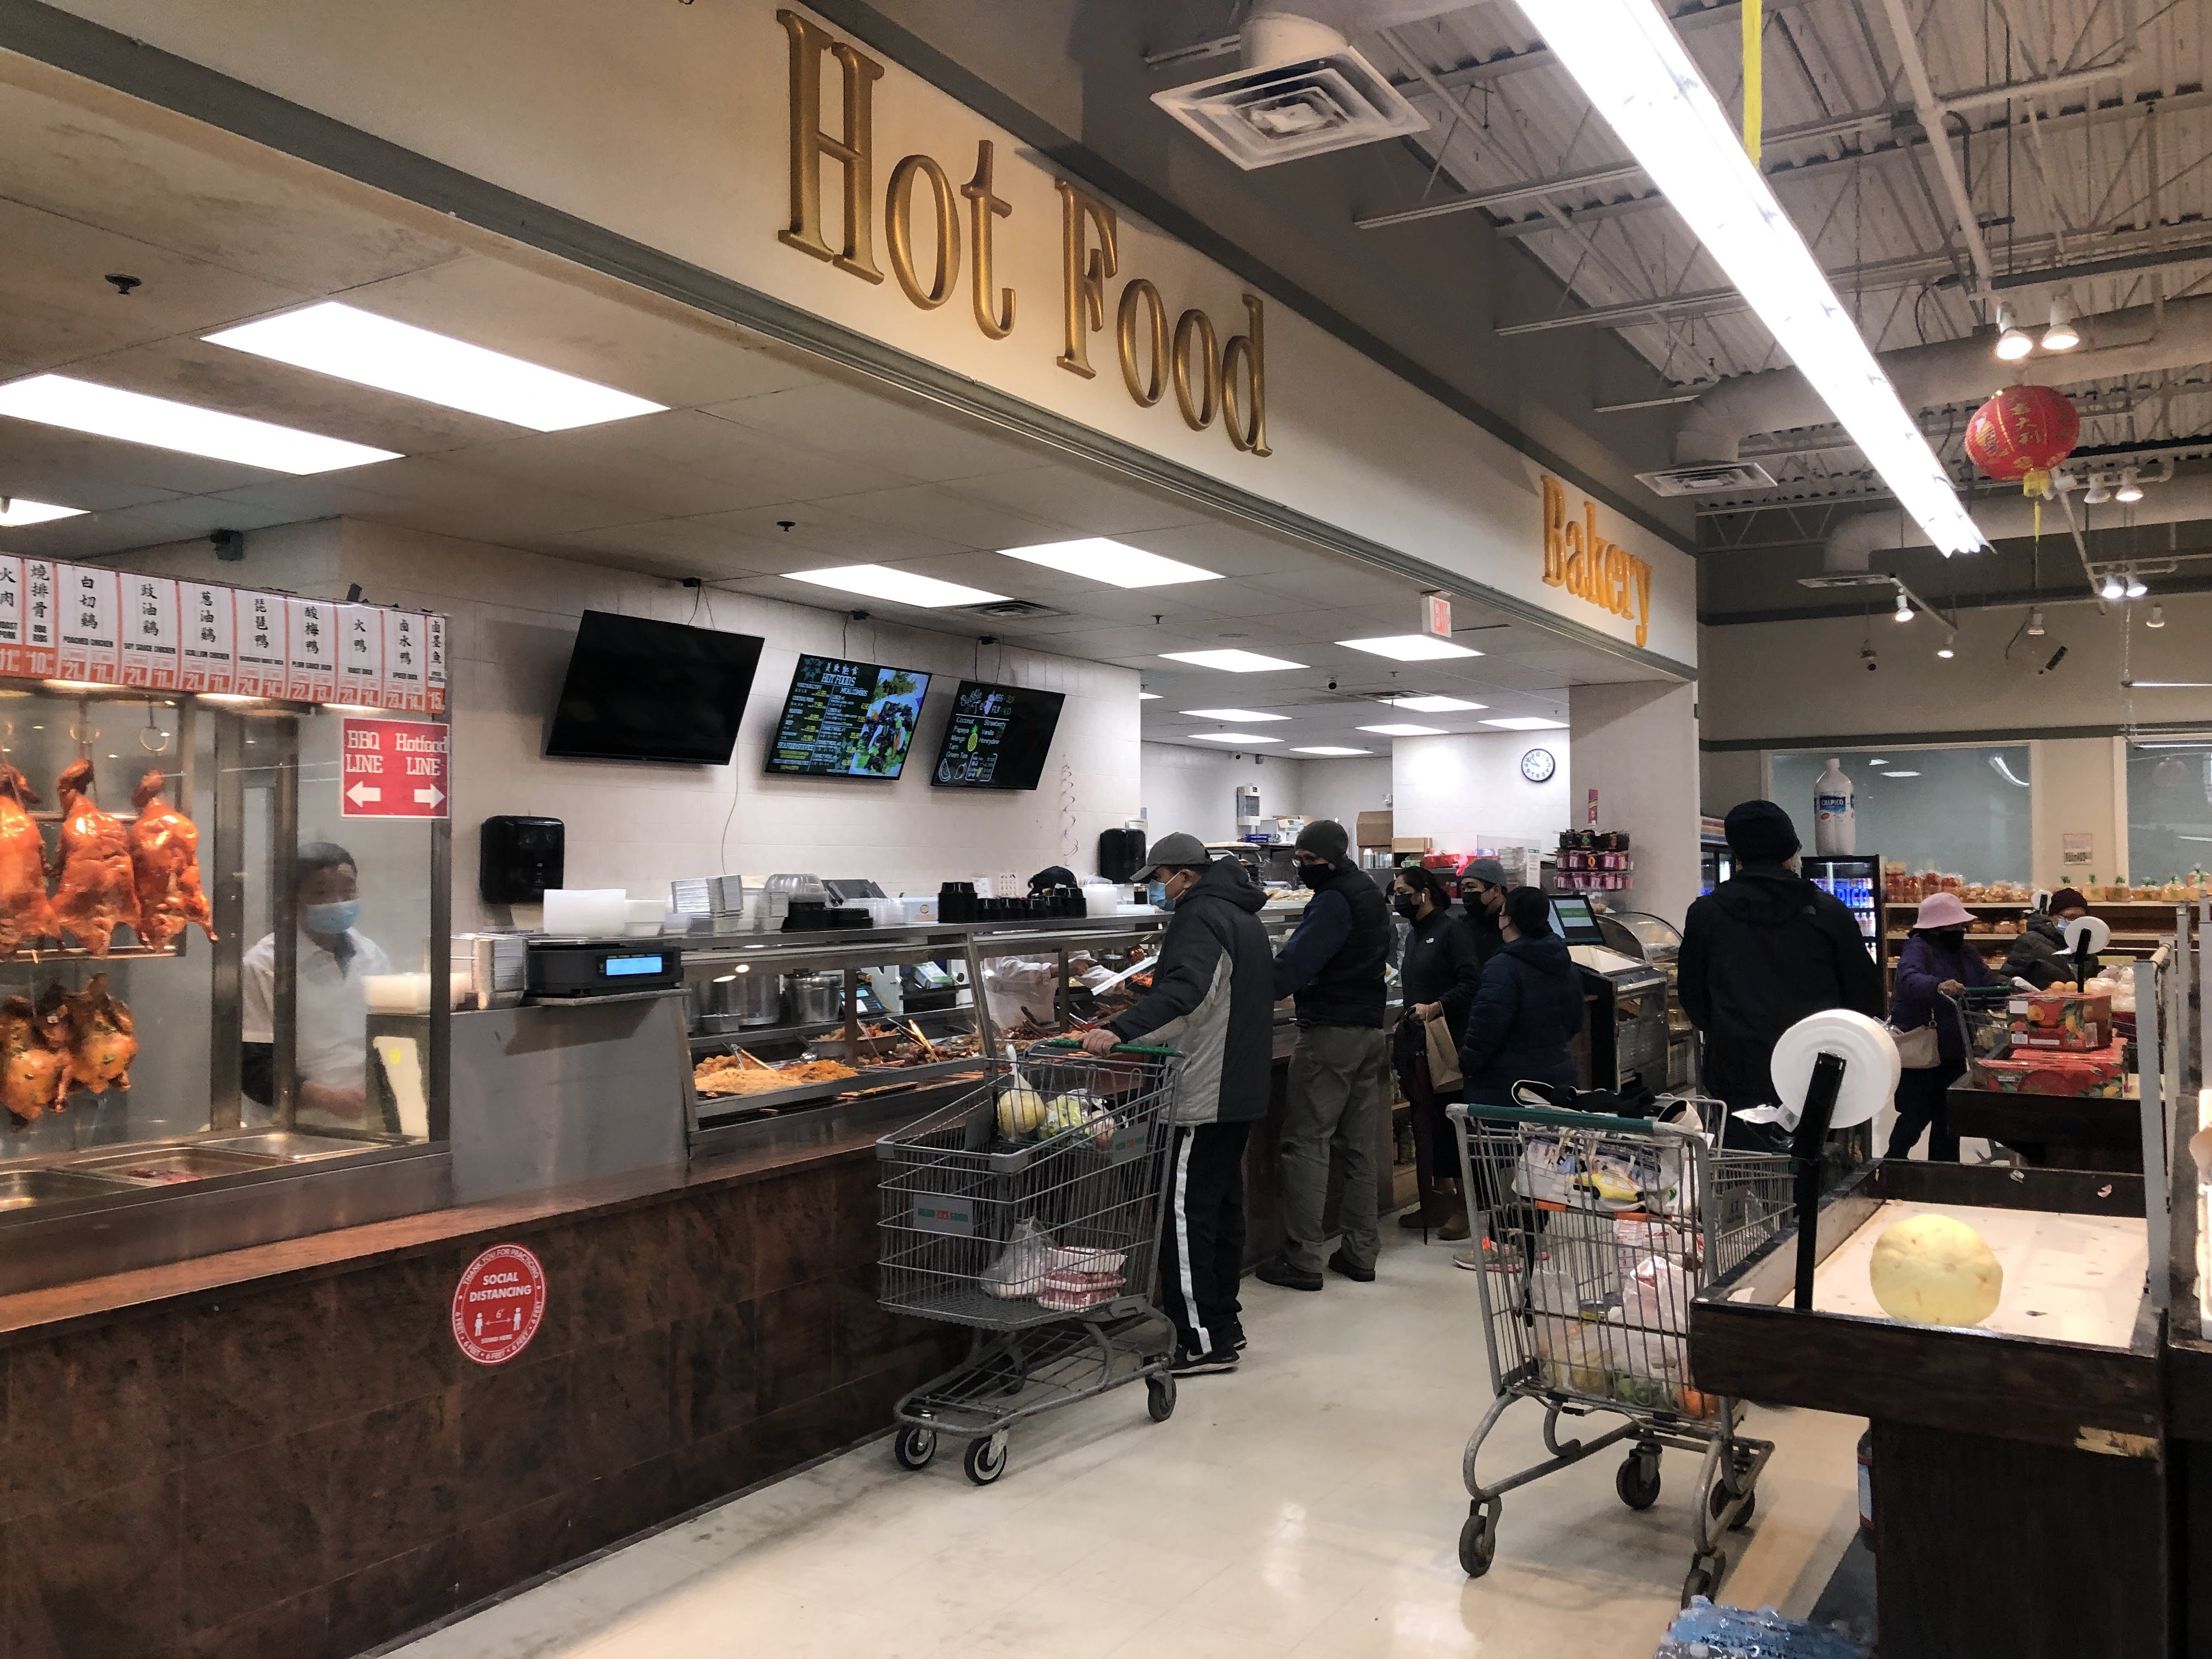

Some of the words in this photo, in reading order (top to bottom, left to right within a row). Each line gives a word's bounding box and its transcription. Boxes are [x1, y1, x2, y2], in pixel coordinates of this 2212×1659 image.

[777, 8, 1015, 340] Hot
[1054, 178, 1272, 458] Food
[1541, 475, 1652, 647] Bakery
[834, 675, 856, 686] FOODS
[961, 689, 982, 706] Bubble
[347, 730, 381, 750] BBQ
[345, 754, 383, 774] LINE
[406, 757, 441, 776] LINE
[462, 1261, 482, 1284] THANK
[511, 1249, 539, 1278] PRACTICING
[483, 1272, 519, 1285] SOCIAL
[469, 1285, 532, 1302] DISTANCING
